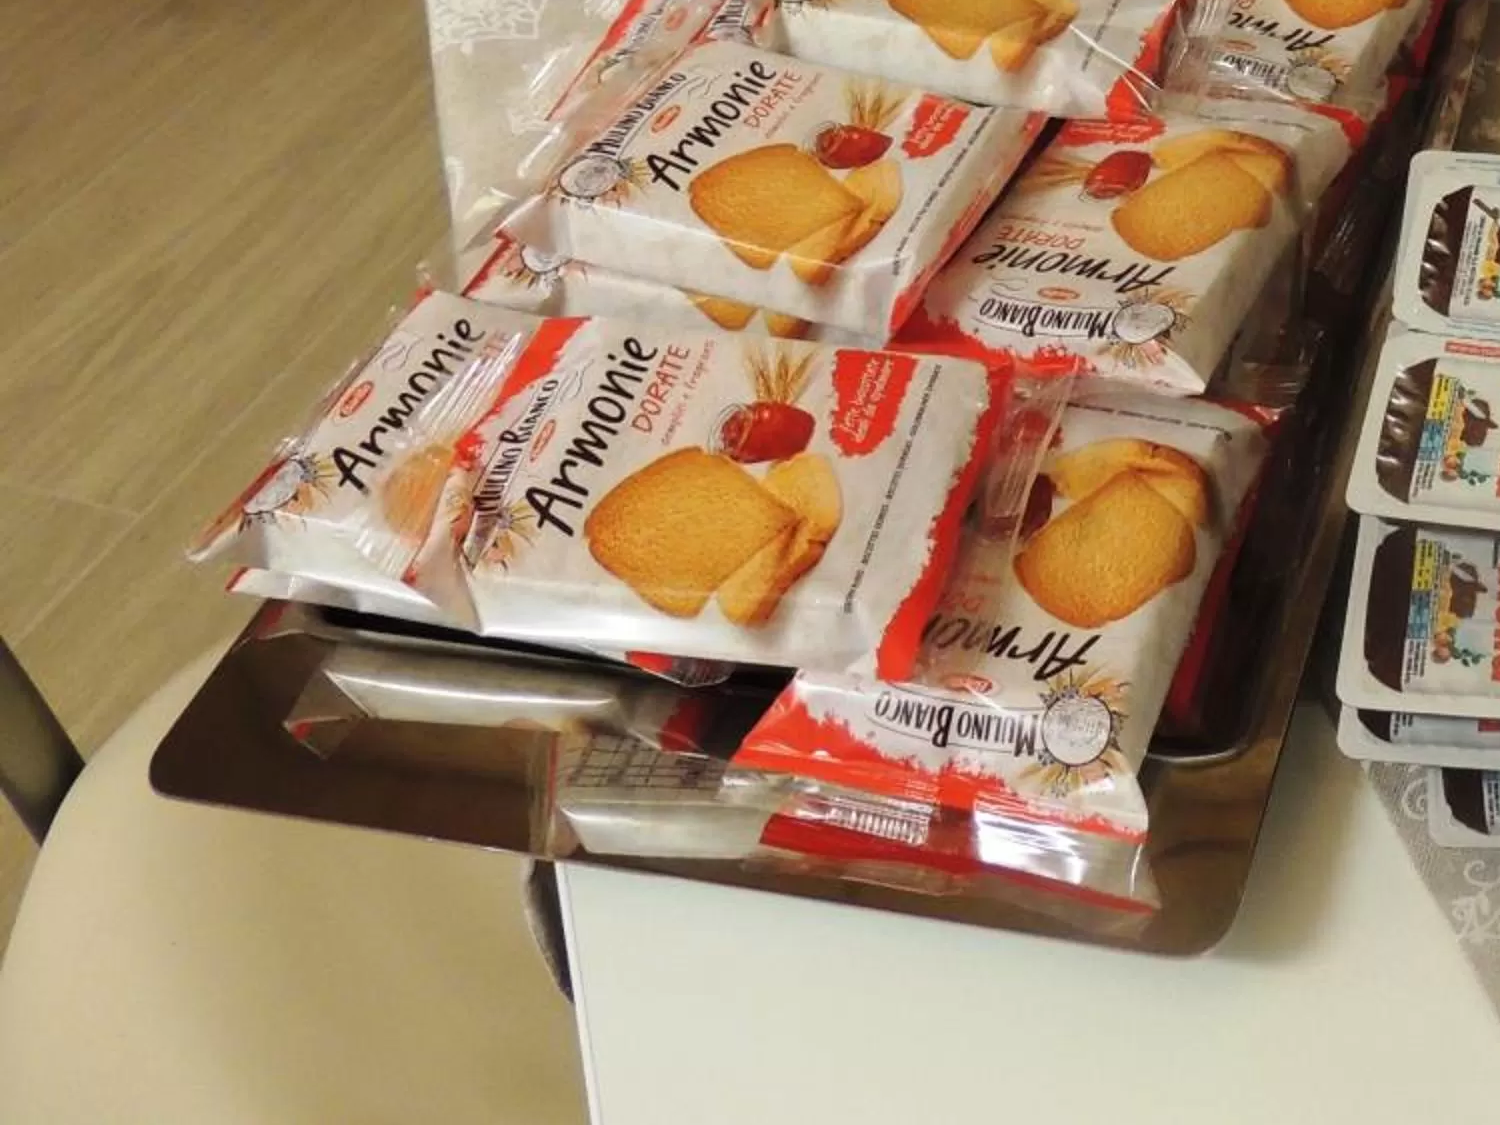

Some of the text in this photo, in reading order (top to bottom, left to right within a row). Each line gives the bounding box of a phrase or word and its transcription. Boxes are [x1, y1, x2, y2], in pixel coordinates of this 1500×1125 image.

[645, 61, 777, 192] Armonie
[743, 69, 801, 129] DORATE
[586, 110, 643, 156] MULINO
[972, 244, 1176, 294] Armonie
[996, 225, 1086, 250] DORATE
[979, 297, 1113, 340] MULINO BIANCO
[333, 318, 486, 496] Armonie
[631, 343, 691, 434] DORATE
[473, 379, 560, 515] MULINO BIANCO
[525, 336, 659, 538] Armonie
[875, 690, 1039, 757] MULINO BIANCO
